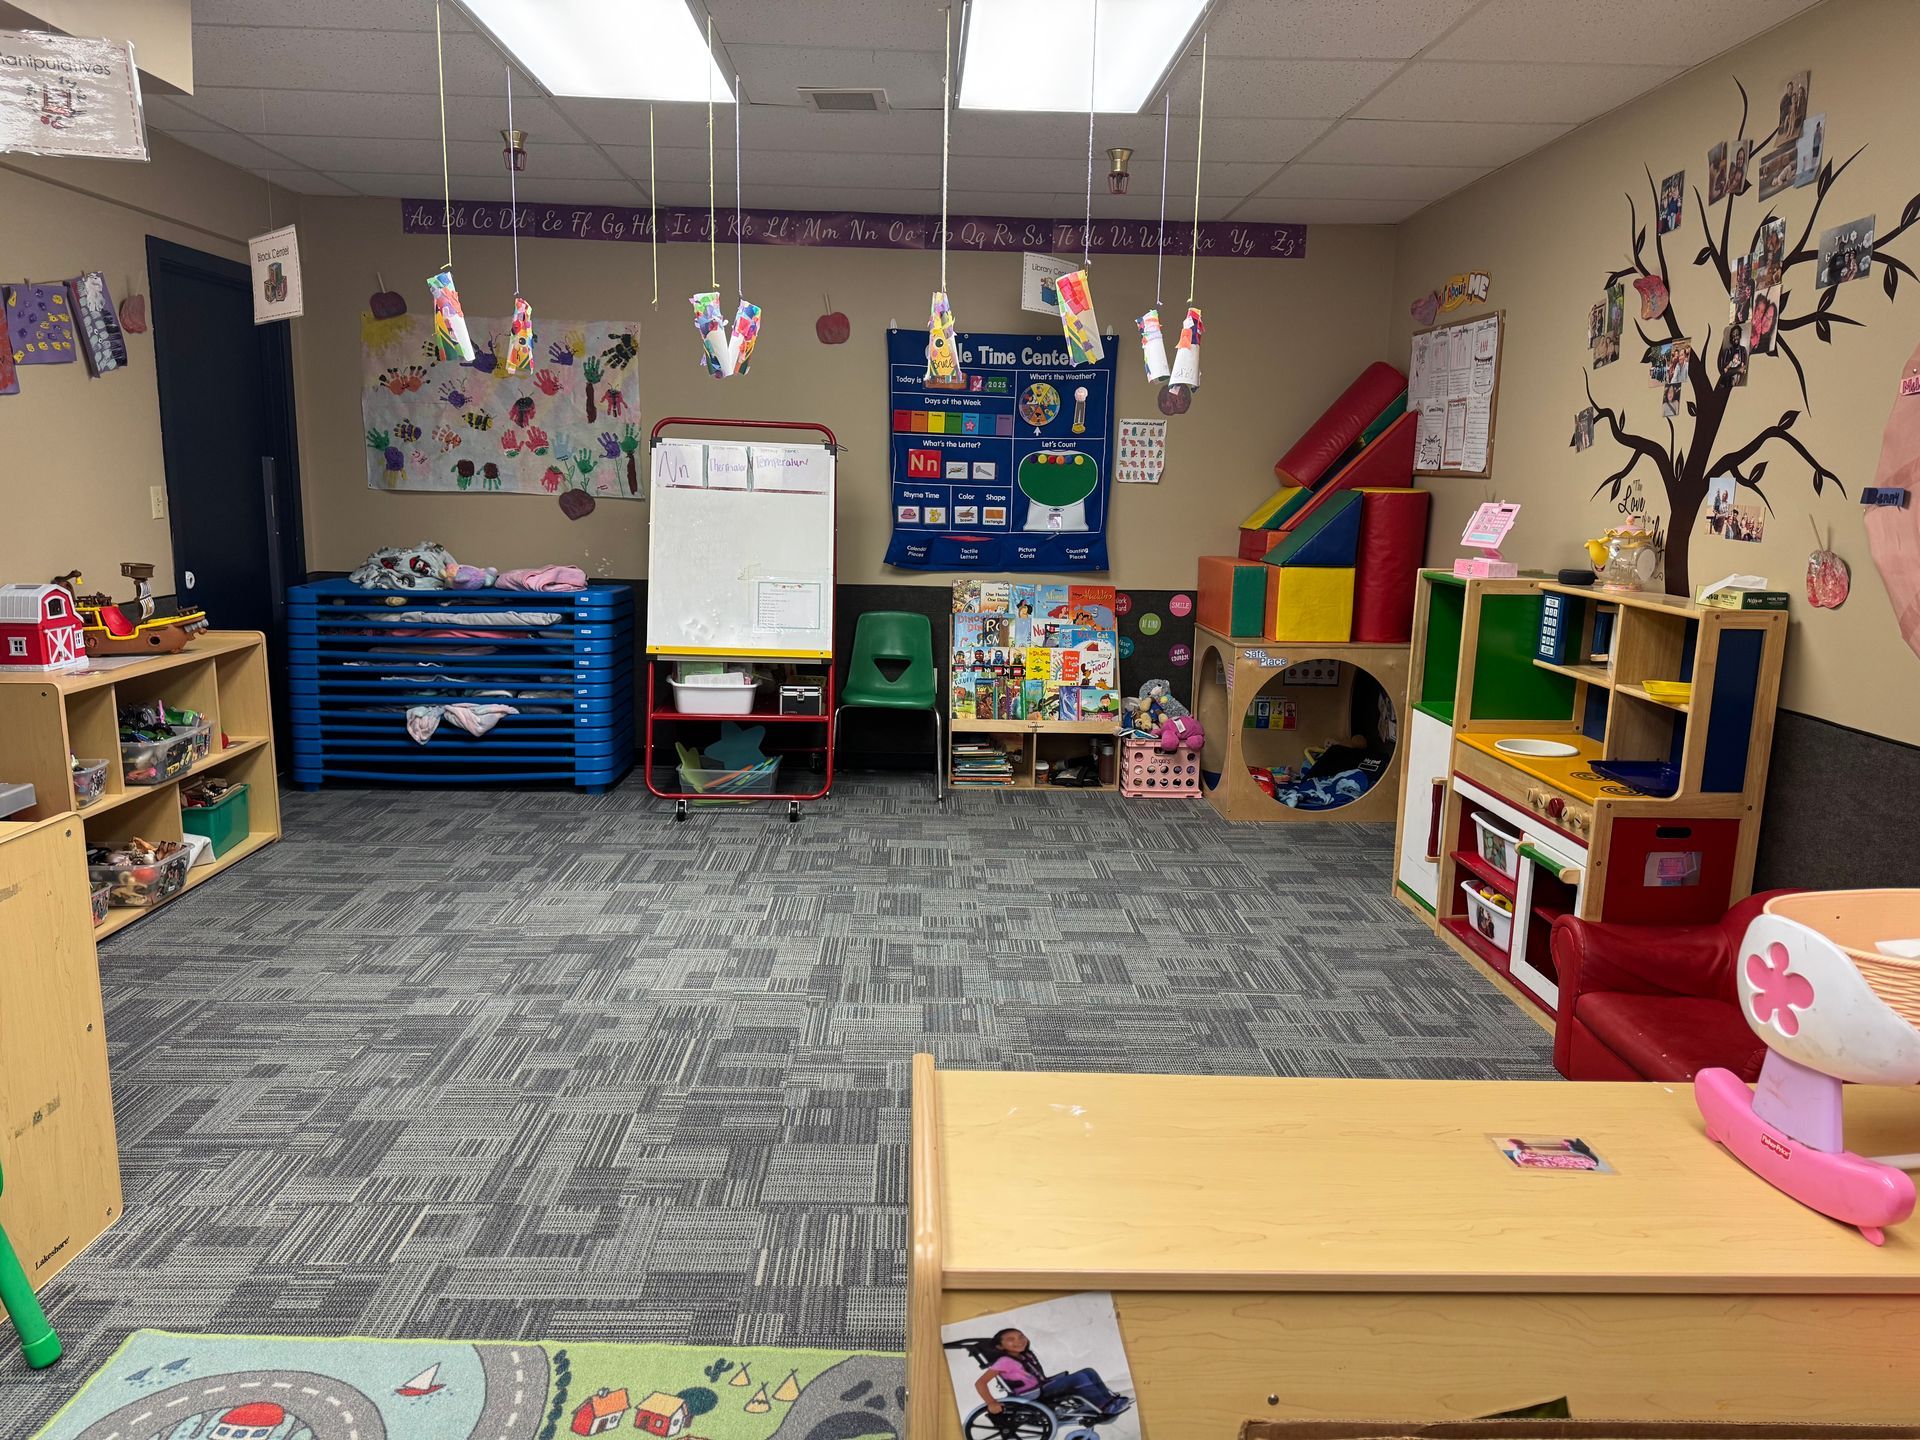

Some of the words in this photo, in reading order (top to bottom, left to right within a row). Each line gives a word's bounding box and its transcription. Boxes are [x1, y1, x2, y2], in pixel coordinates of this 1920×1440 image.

[410, 206, 435, 227] Aa
[472, 207, 494, 229] Cc
[542, 210, 564, 232] Ee
[601, 213, 626, 239] Gg
[802, 218, 841, 242] Mm
[849, 218, 878, 242] Nn
[993, 223, 1016, 245] Rr
[1022, 224, 1045, 246] Ss
[1031, 263, 1052, 274] Library
[1467, 271, 1491, 303] ME
[978, 345, 1016, 365] Time
[1021, 347, 1069, 366] Cente
[896, 376, 914, 384] Today
[1029, 373, 1052, 381] What's
[1065, 373, 1096, 381] Weather?
[924, 398, 941, 407] Days
[922, 440, 945, 448] What's
[659, 451, 689, 482] Nn
[910, 454, 938, 472] Nn
[986, 494, 1006, 502] Shape
[1618, 485, 1646, 515] Love
[1096, 631, 1108, 639] Cat
[1244, 650, 1265, 658] Safe
[1092, 660, 1110, 673] MOO!
[1260, 657, 1287, 666] Place
[35, 1235, 70, 1270] Lakeshore
